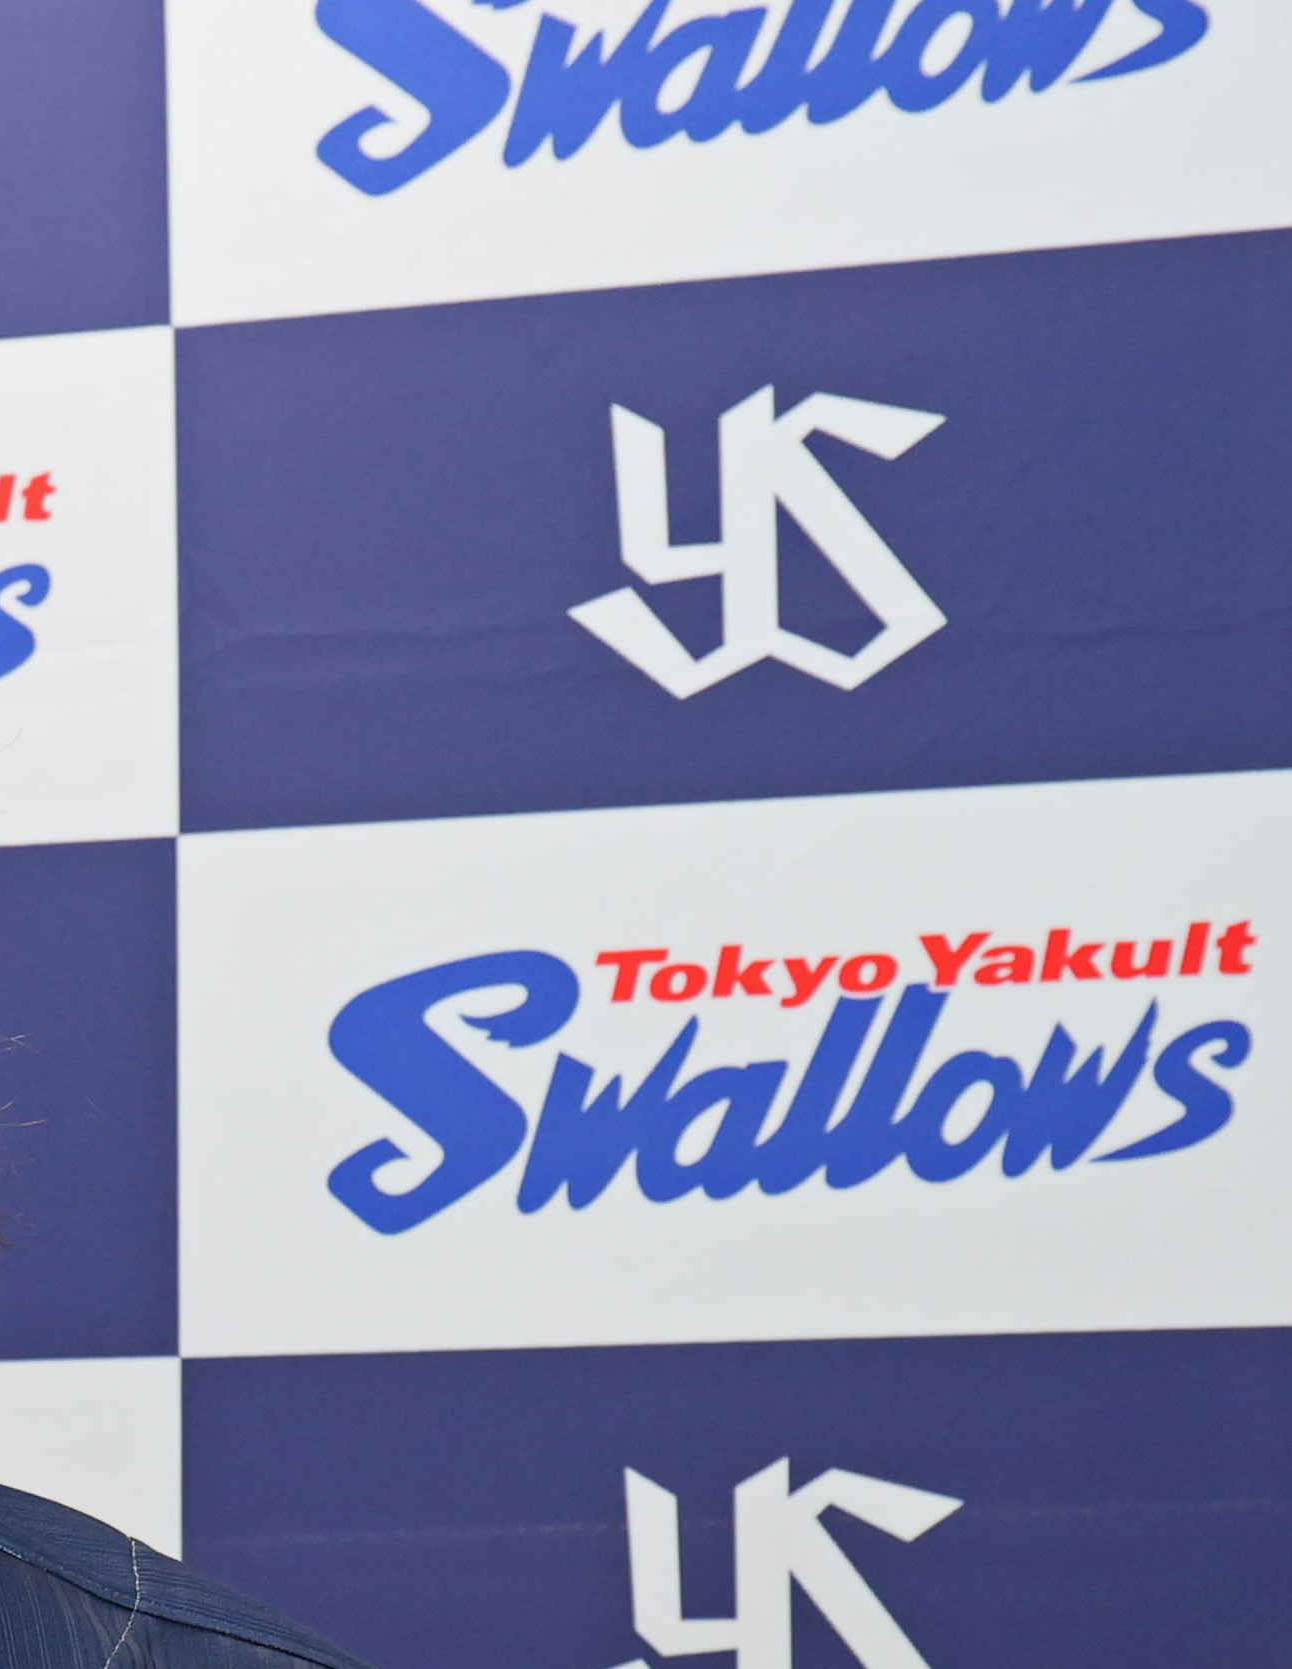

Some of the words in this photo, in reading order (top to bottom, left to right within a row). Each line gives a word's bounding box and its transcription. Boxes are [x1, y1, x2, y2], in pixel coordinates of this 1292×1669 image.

[595, 944, 899, 1008] Tokyo
[919, 920, 1257, 986] Yakult
[327, 949, 1253, 1236] Swallows
